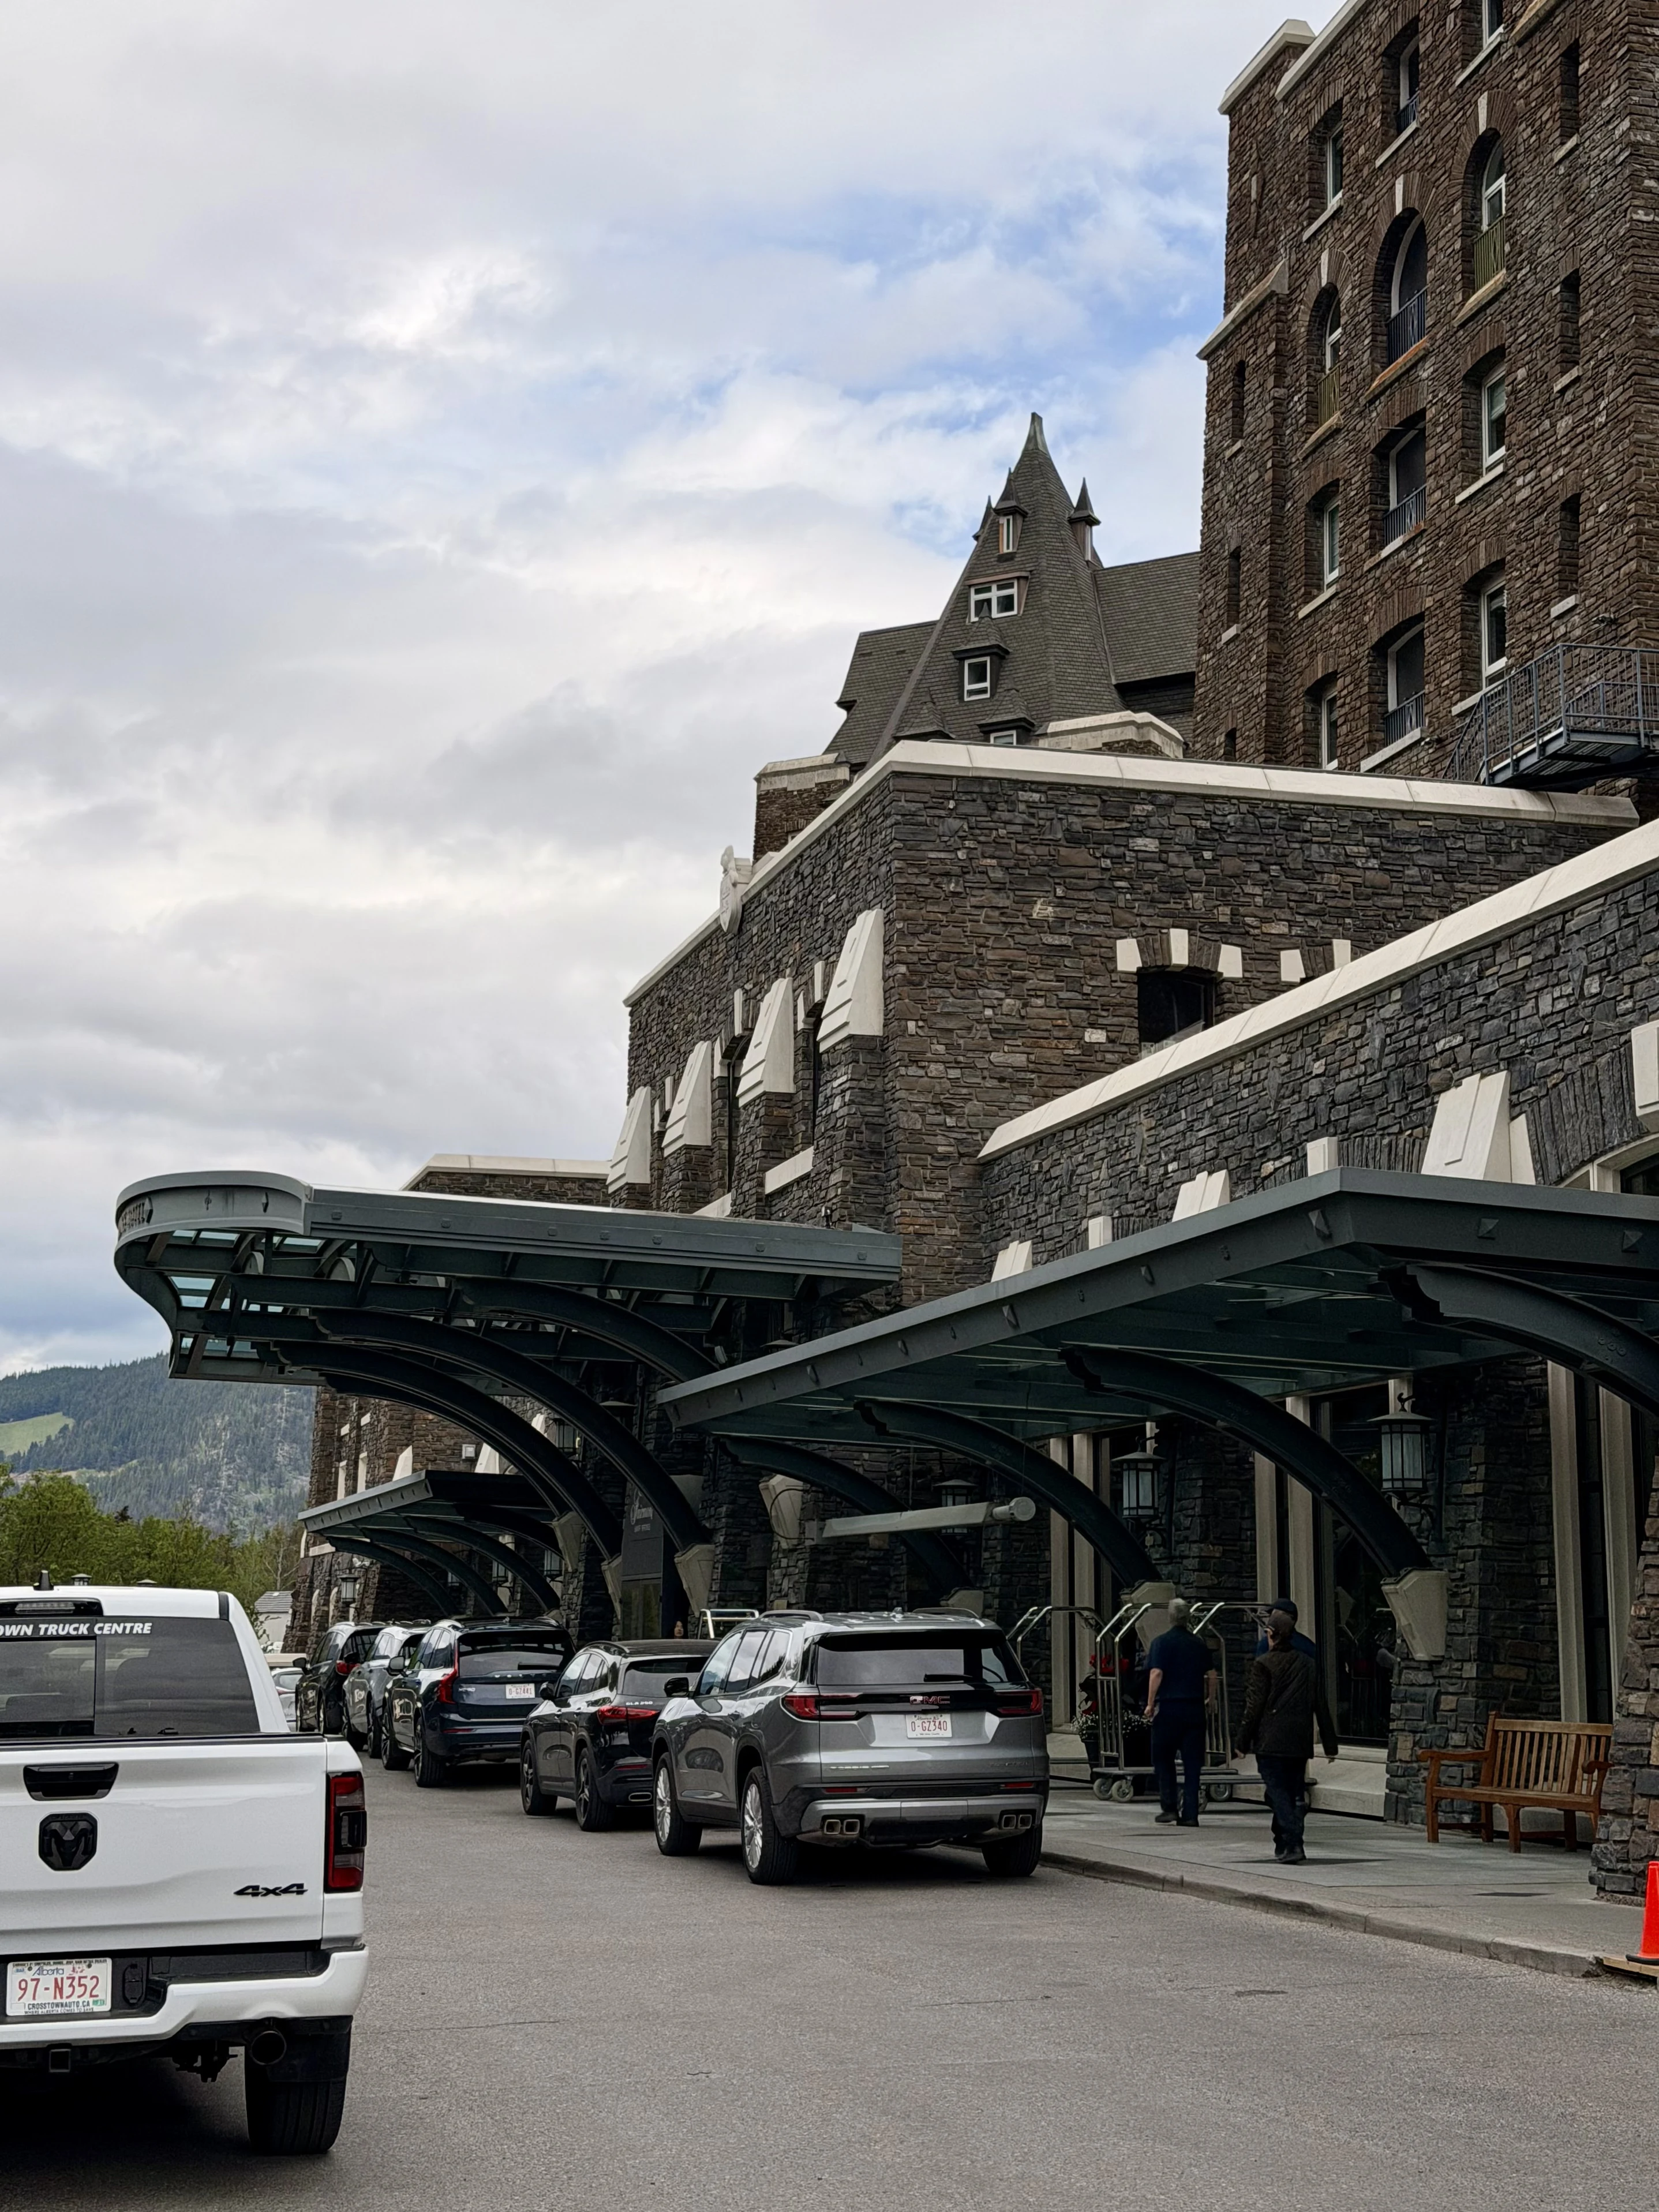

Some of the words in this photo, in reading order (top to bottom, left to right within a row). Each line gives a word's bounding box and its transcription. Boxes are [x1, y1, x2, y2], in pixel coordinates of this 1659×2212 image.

[39, 1623, 90, 1635] TRUCK
[93, 1622, 152, 1634] CENTRE
[909, 1696, 950, 1704] GMC
[233, 1883, 308, 1897] 4x4
[32, 1966, 65, 1976] Alberta
[18, 1975, 99, 2001] 97-N352
[27, 2000, 90, 2011] CROSSTOWNAUTO.CA
